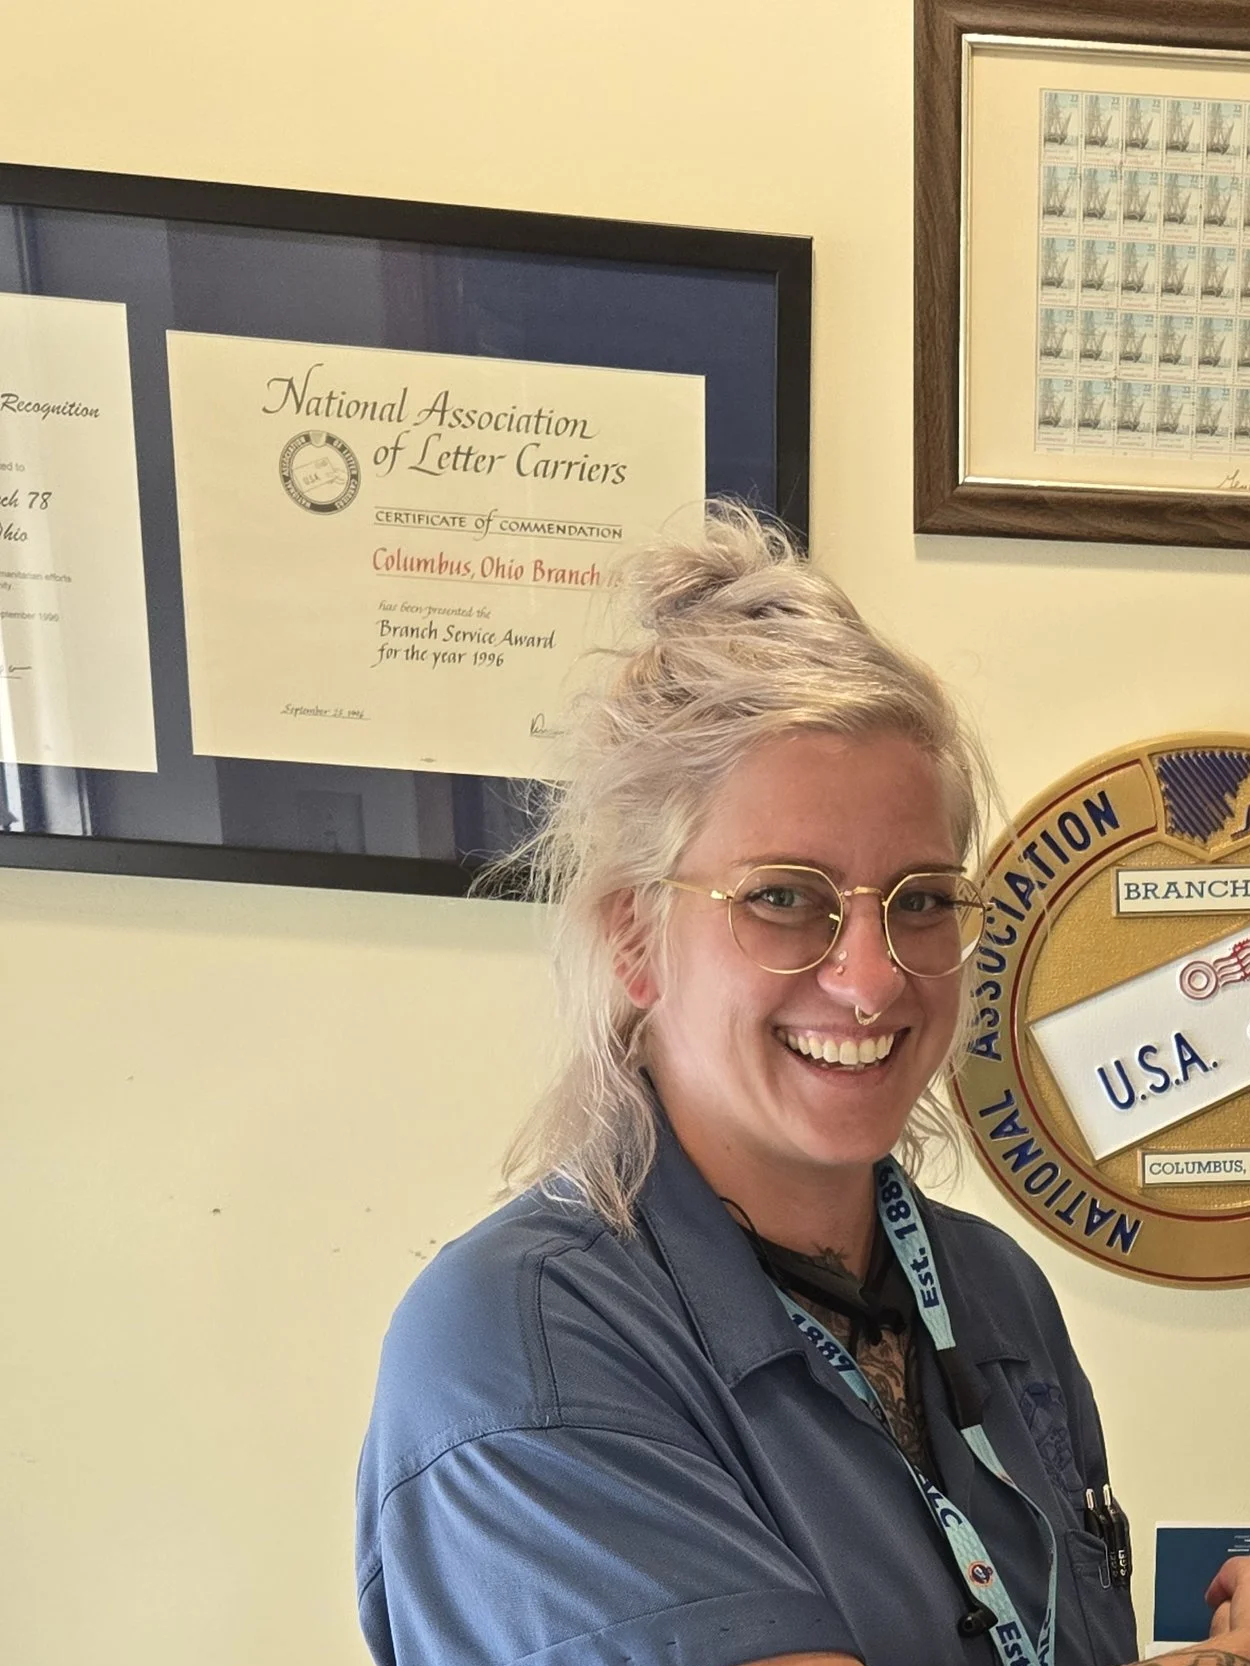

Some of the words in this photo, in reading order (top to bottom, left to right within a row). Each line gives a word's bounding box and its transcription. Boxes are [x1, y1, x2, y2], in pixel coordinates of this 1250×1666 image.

[0, 392, 100, 421] Recognition
[262, 363, 408, 424] National
[413, 390, 600, 439] Association
[373, 430, 410, 477] of
[408, 433, 506, 477] Letter
[516, 443, 629, 485] Carriers
[0, 489, 19, 508] ch
[28, 491, 52, 510] 78
[375, 510, 467, 528] CERTIFICATE
[473, 508, 498, 541] of
[500, 520, 623, 539] COMMENDATION
[372, 547, 477, 579] Columbus,
[480, 555, 524, 581] Ohio
[532, 559, 600, 588] Branch
[378, 600, 398, 612] has
[376, 619, 438, 641] Branch
[442, 624, 497, 645] Service
[495, 628, 556, 650] Award
[370, 643, 398, 668] for
[404, 645, 428, 662] the
[433, 650, 467, 670] year
[473, 651, 504, 668] 1996
[968, 790, 1120, 1062] ASSOCIATION
[1096, 1031, 1219, 1110] U.S.A.
[979, 1089, 1142, 1254] NATIONAL
[1149, 1160, 1247, 1176] COLUMBUS,
[879, 1166, 918, 1240] 1889
[910, 1247, 940, 1309] Est.
